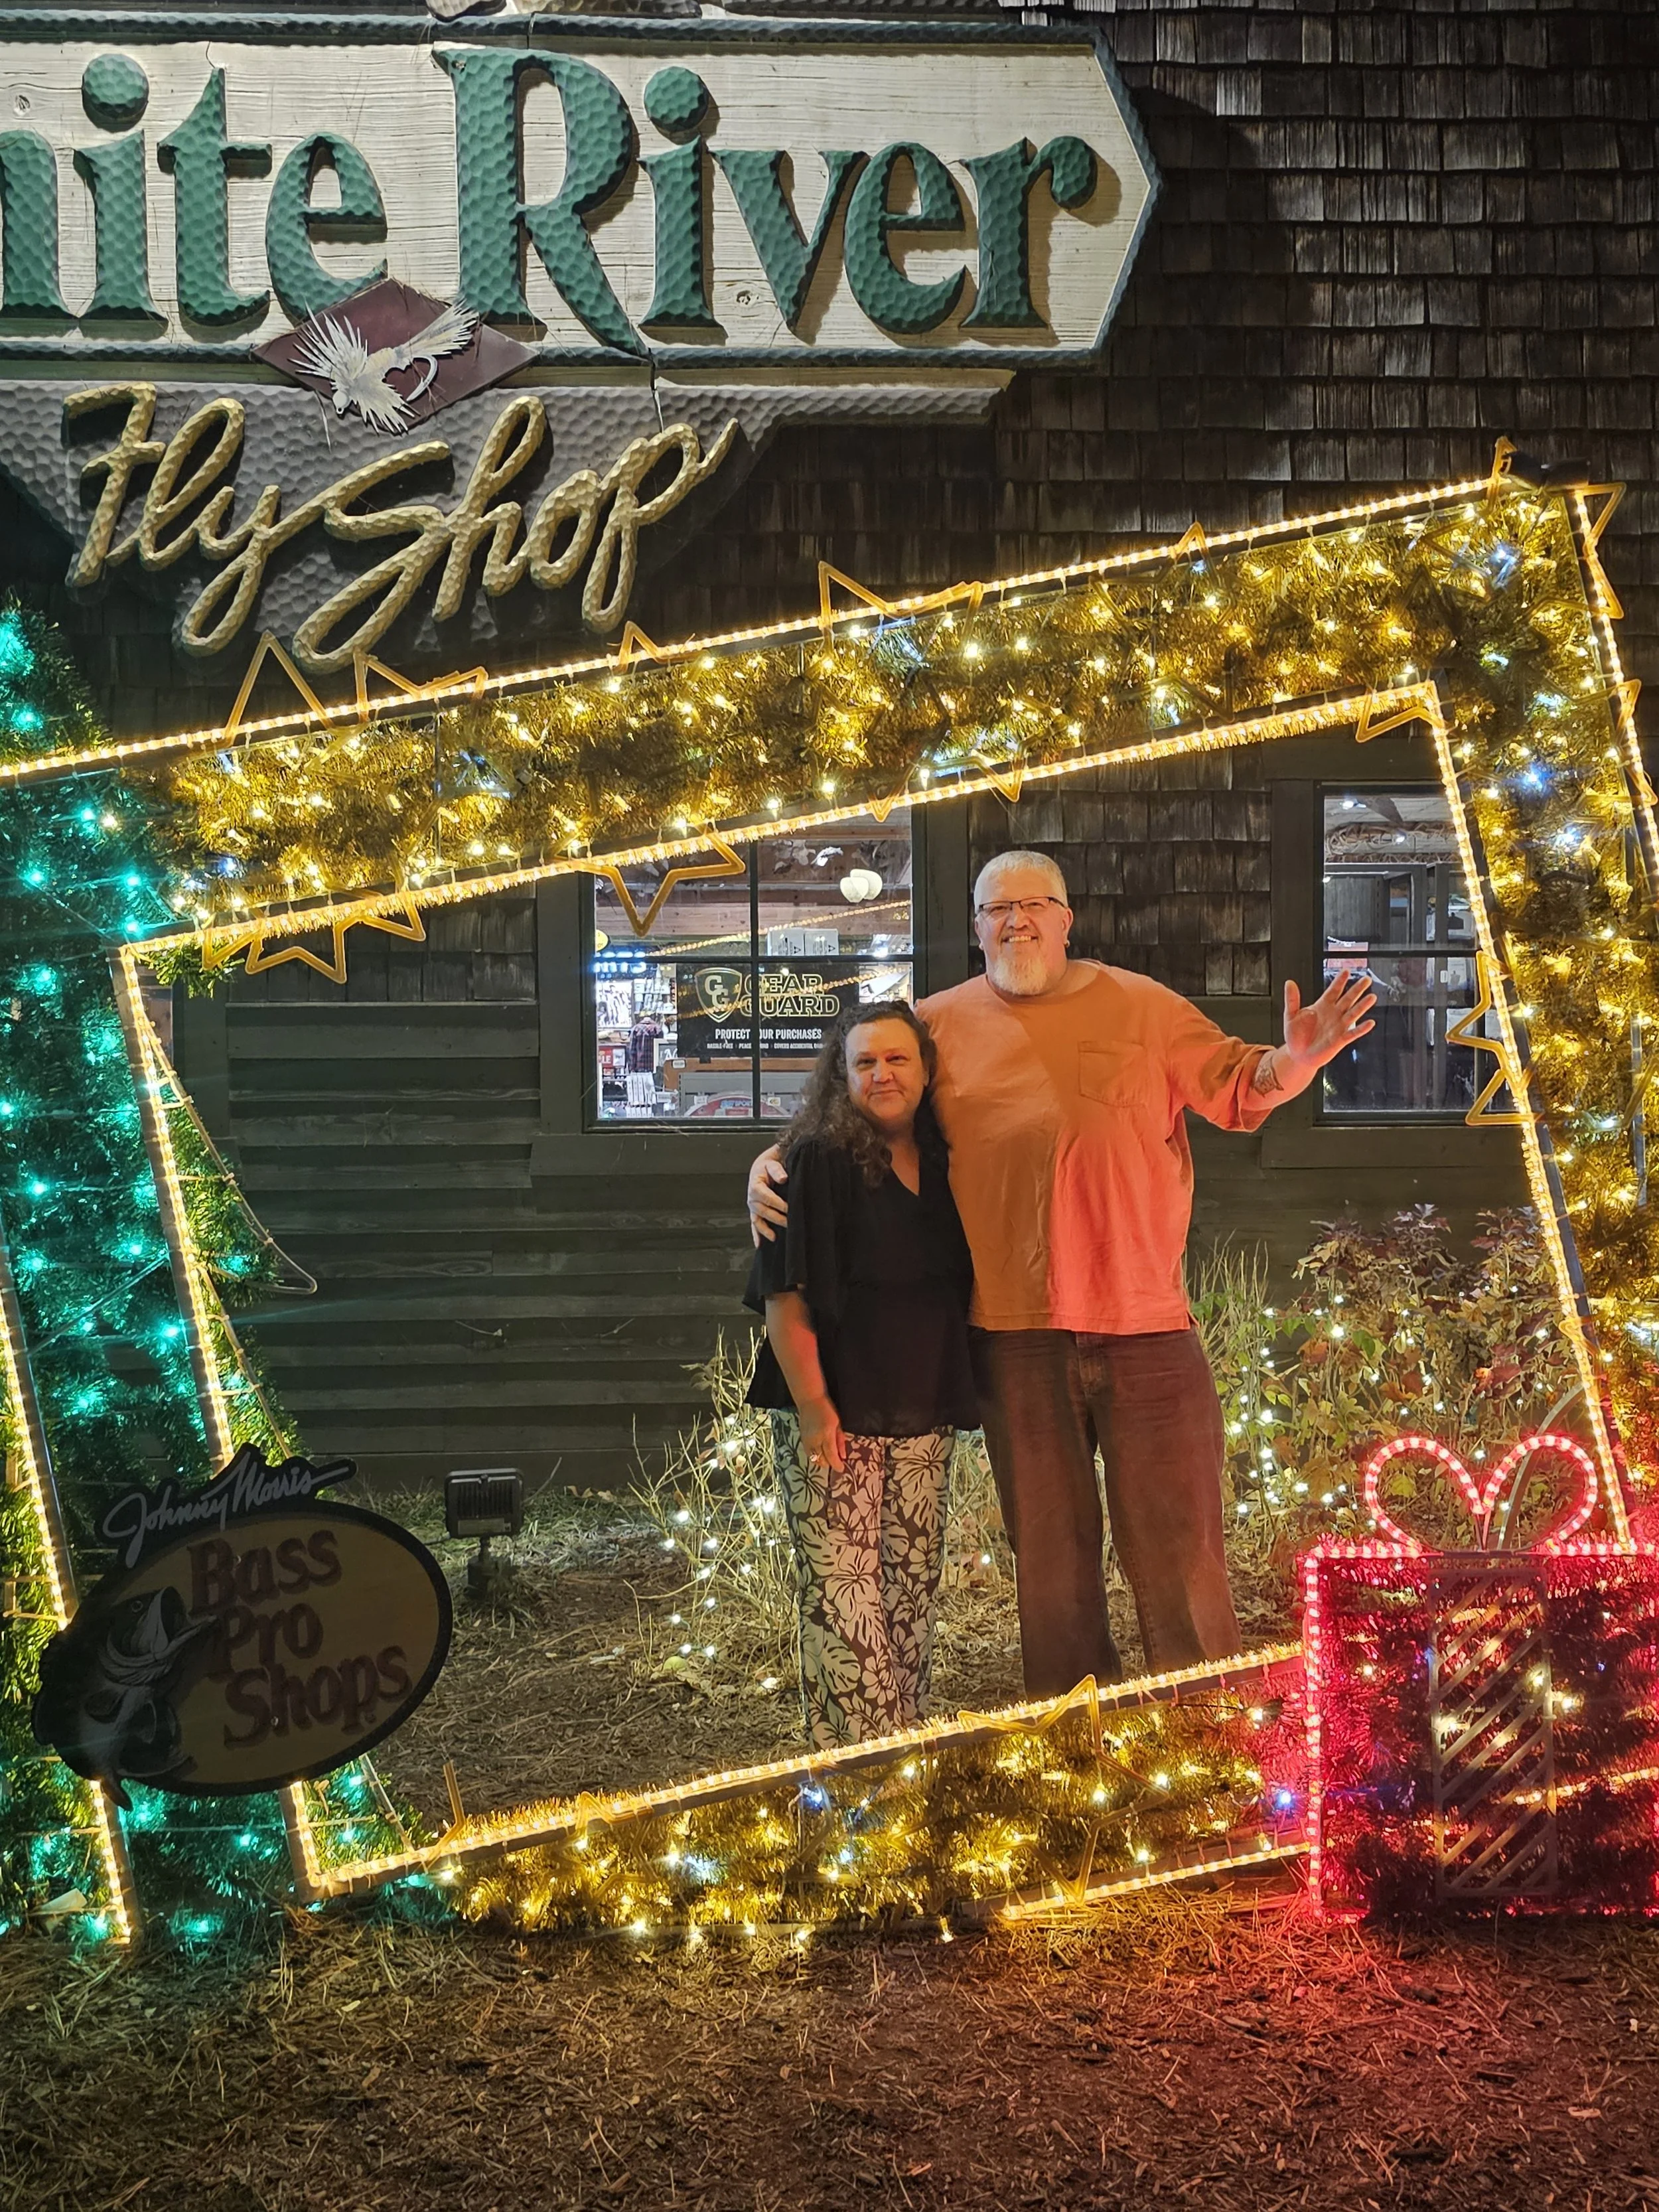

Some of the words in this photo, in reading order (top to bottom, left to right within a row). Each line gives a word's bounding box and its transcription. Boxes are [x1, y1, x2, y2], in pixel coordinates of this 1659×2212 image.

[431, 48, 1096, 353] River
[62, 381, 284, 656] Fly
[289, 396, 739, 665] Shop
[715, 1028, 751, 1040] PROTECT
[775, 1028, 822, 1040] PURCHASES
[740, 994, 840, 1017] GUARD
[103, 1485, 227, 1566] Johnny
[187, 1529, 342, 1615] Bass
[206, 1602, 324, 1683] Pro
[224, 1646, 413, 1746] Shops
